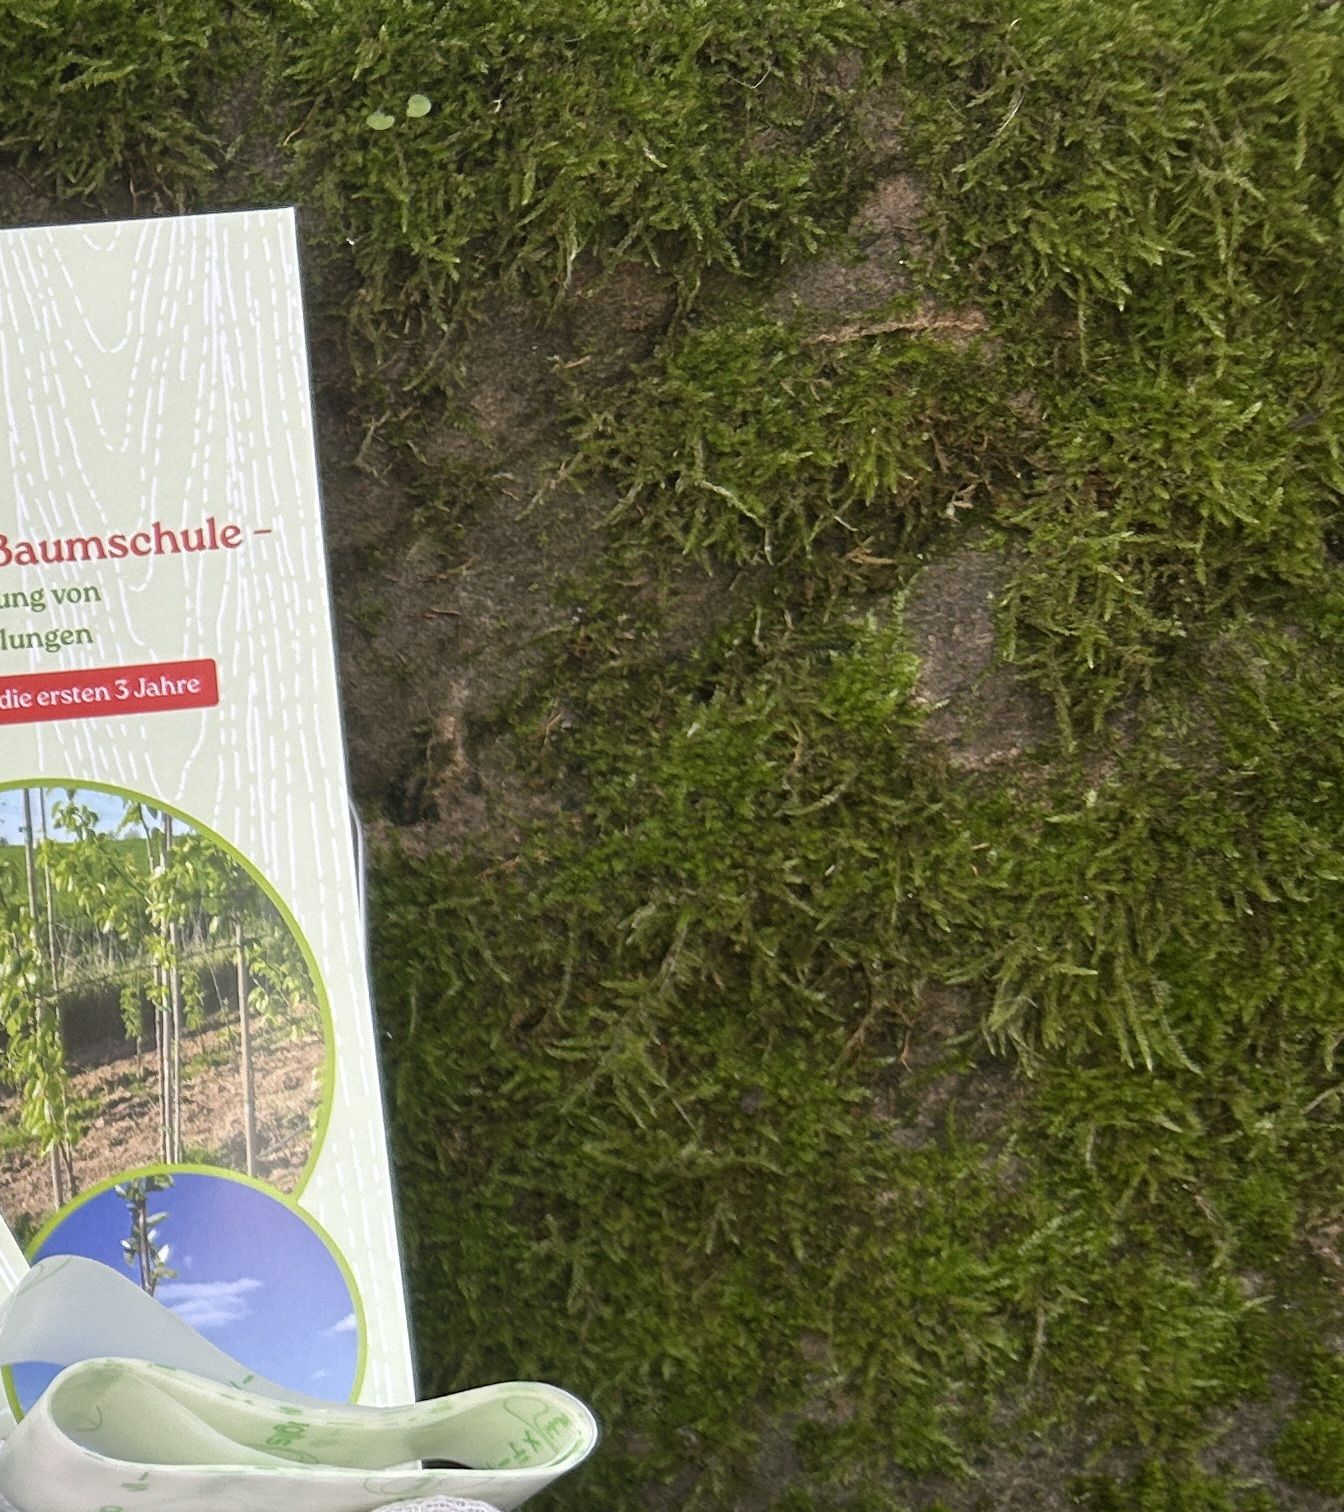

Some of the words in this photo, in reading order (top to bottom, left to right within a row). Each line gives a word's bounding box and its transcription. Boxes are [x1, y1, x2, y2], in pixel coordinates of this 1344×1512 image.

[51, 583, 101, 604] von
[37, 681, 110, 707] ersten
[114, 679, 130, 698] 3
[132, 675, 200, 701] Jahre
